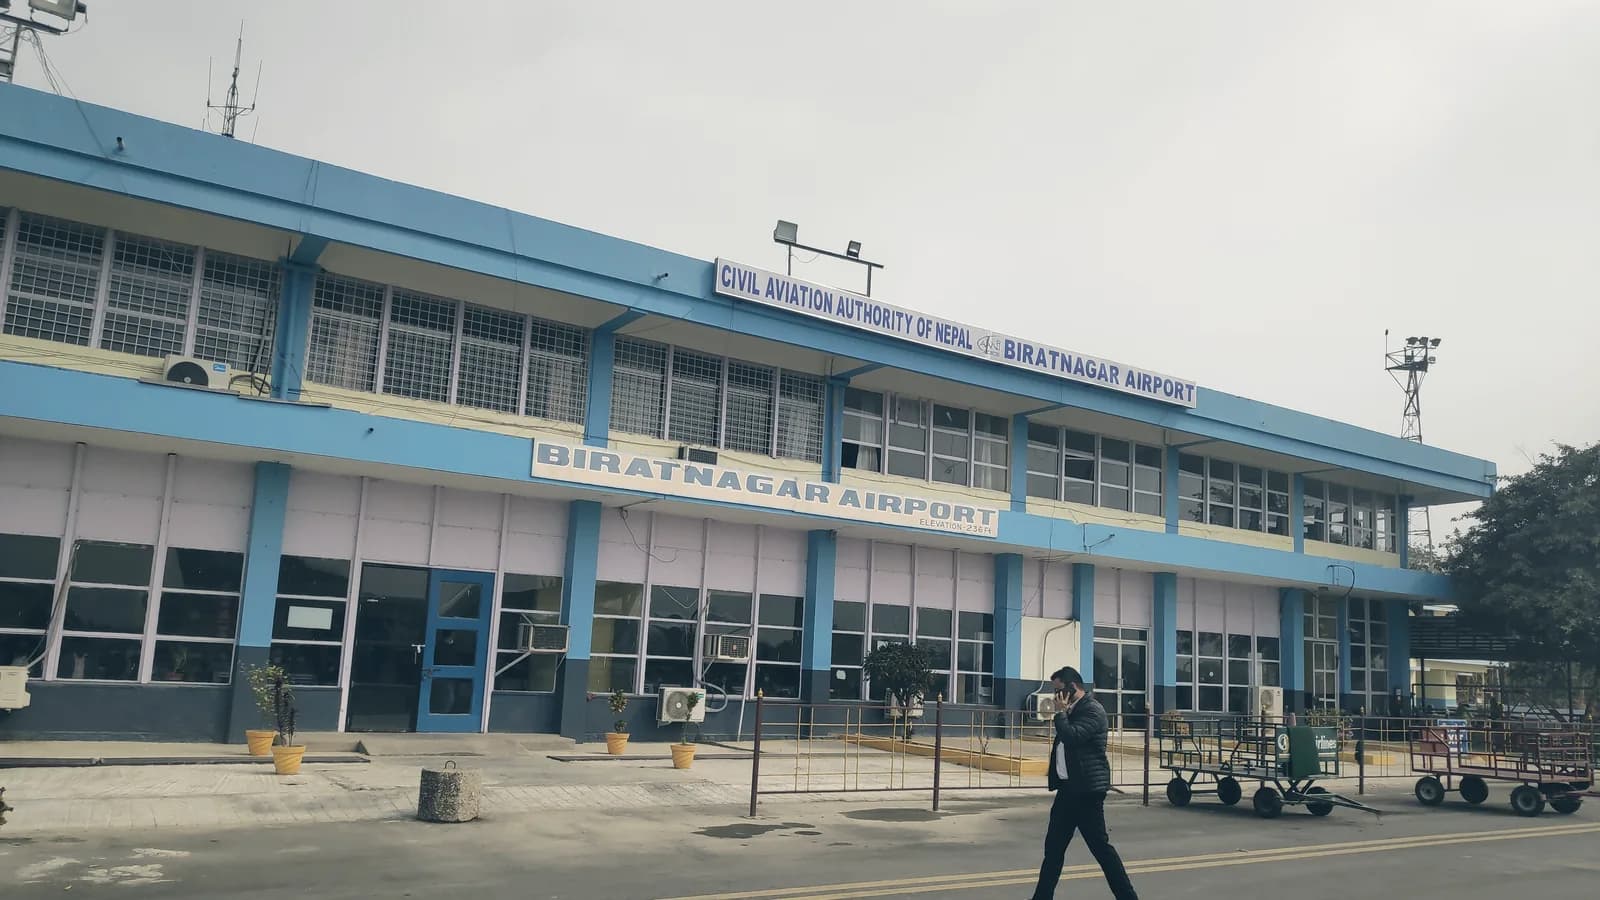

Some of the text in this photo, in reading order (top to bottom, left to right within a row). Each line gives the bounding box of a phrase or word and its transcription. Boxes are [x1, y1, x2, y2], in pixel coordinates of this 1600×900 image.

[721, 264, 760, 296] CIVIL
[765, 277, 833, 314] AVIATION
[836, 296, 912, 333] AUTHORITY
[916, 319, 933, 341] OF
[935, 323, 973, 351] NEPAL
[1004, 340, 1119, 384] BIRATNAGAR
[1125, 370, 1194, 402] AIRPORT
[537, 444, 996, 525] BIRATNAGAR AIRPORT
